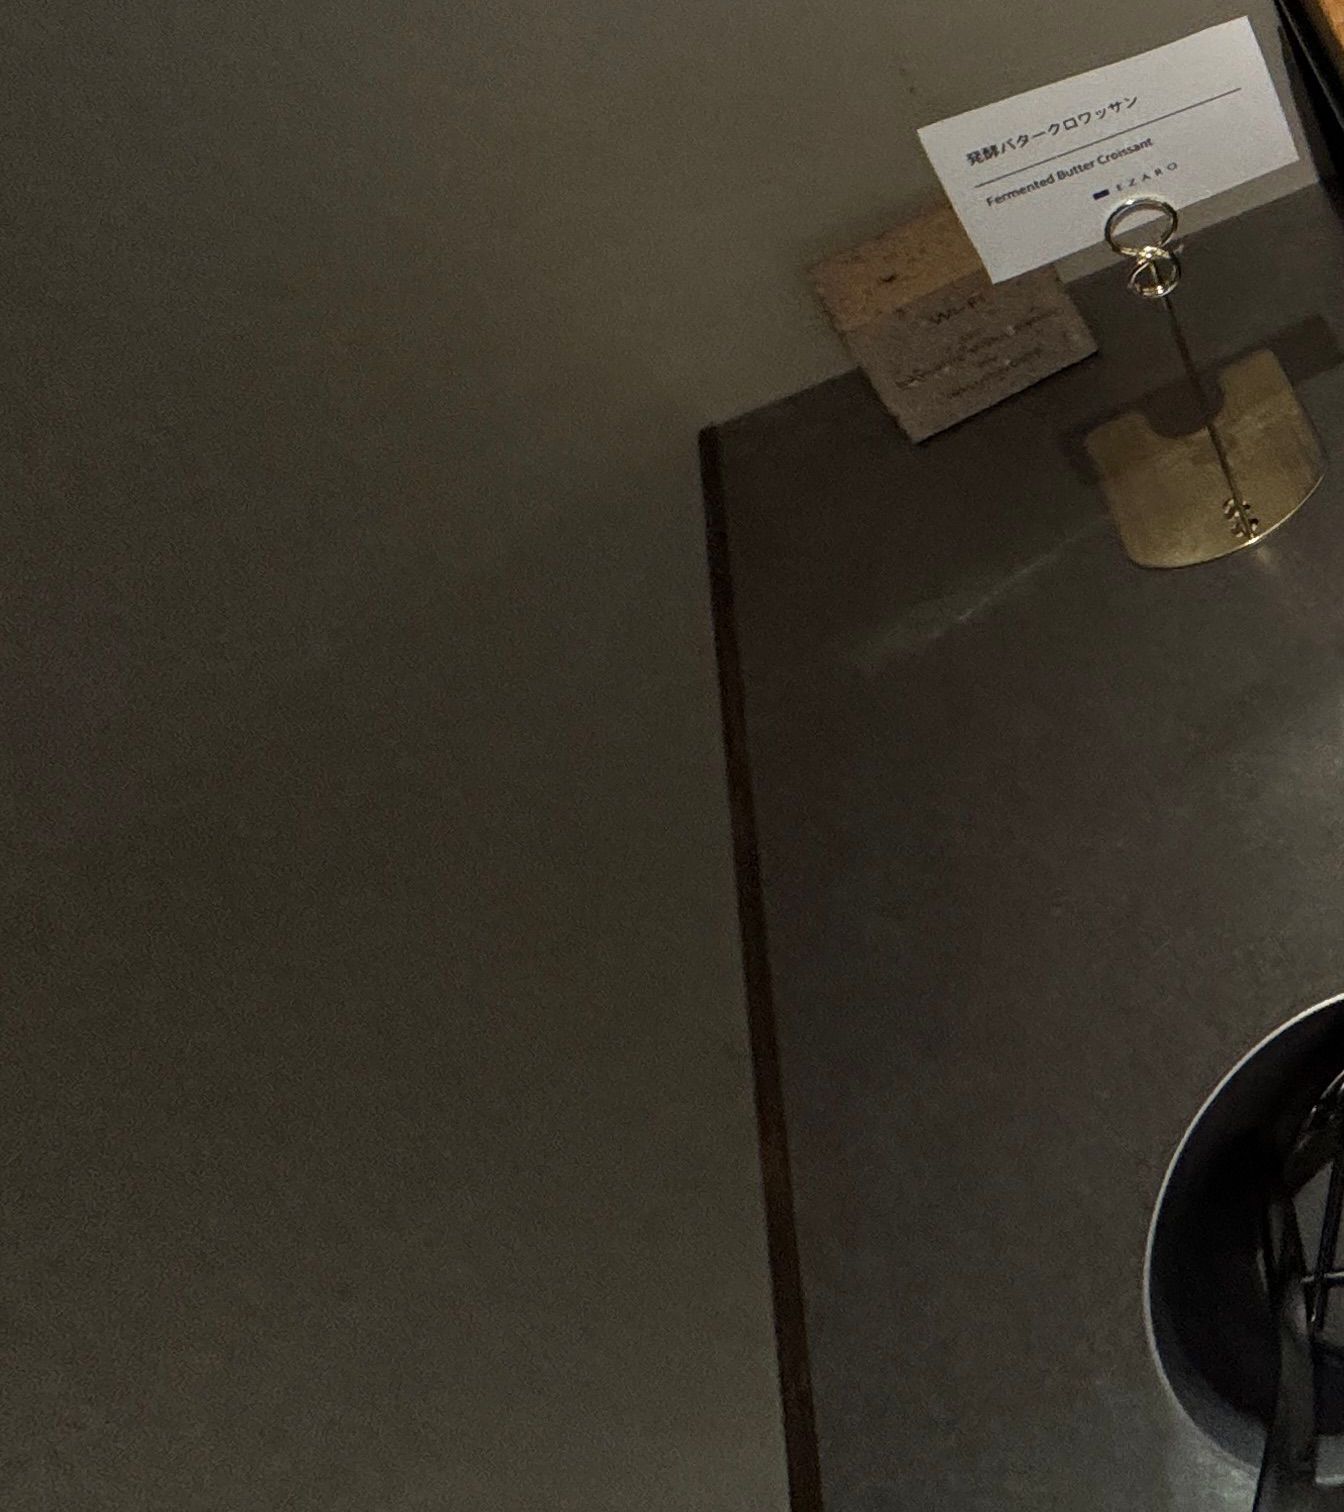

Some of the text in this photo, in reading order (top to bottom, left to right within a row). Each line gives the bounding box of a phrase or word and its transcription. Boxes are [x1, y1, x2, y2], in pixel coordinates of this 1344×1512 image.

[966, 96, 1138, 166] 発酵バタークロワッサン
[986, 138, 1153, 207] Fermented Butter Croissant
